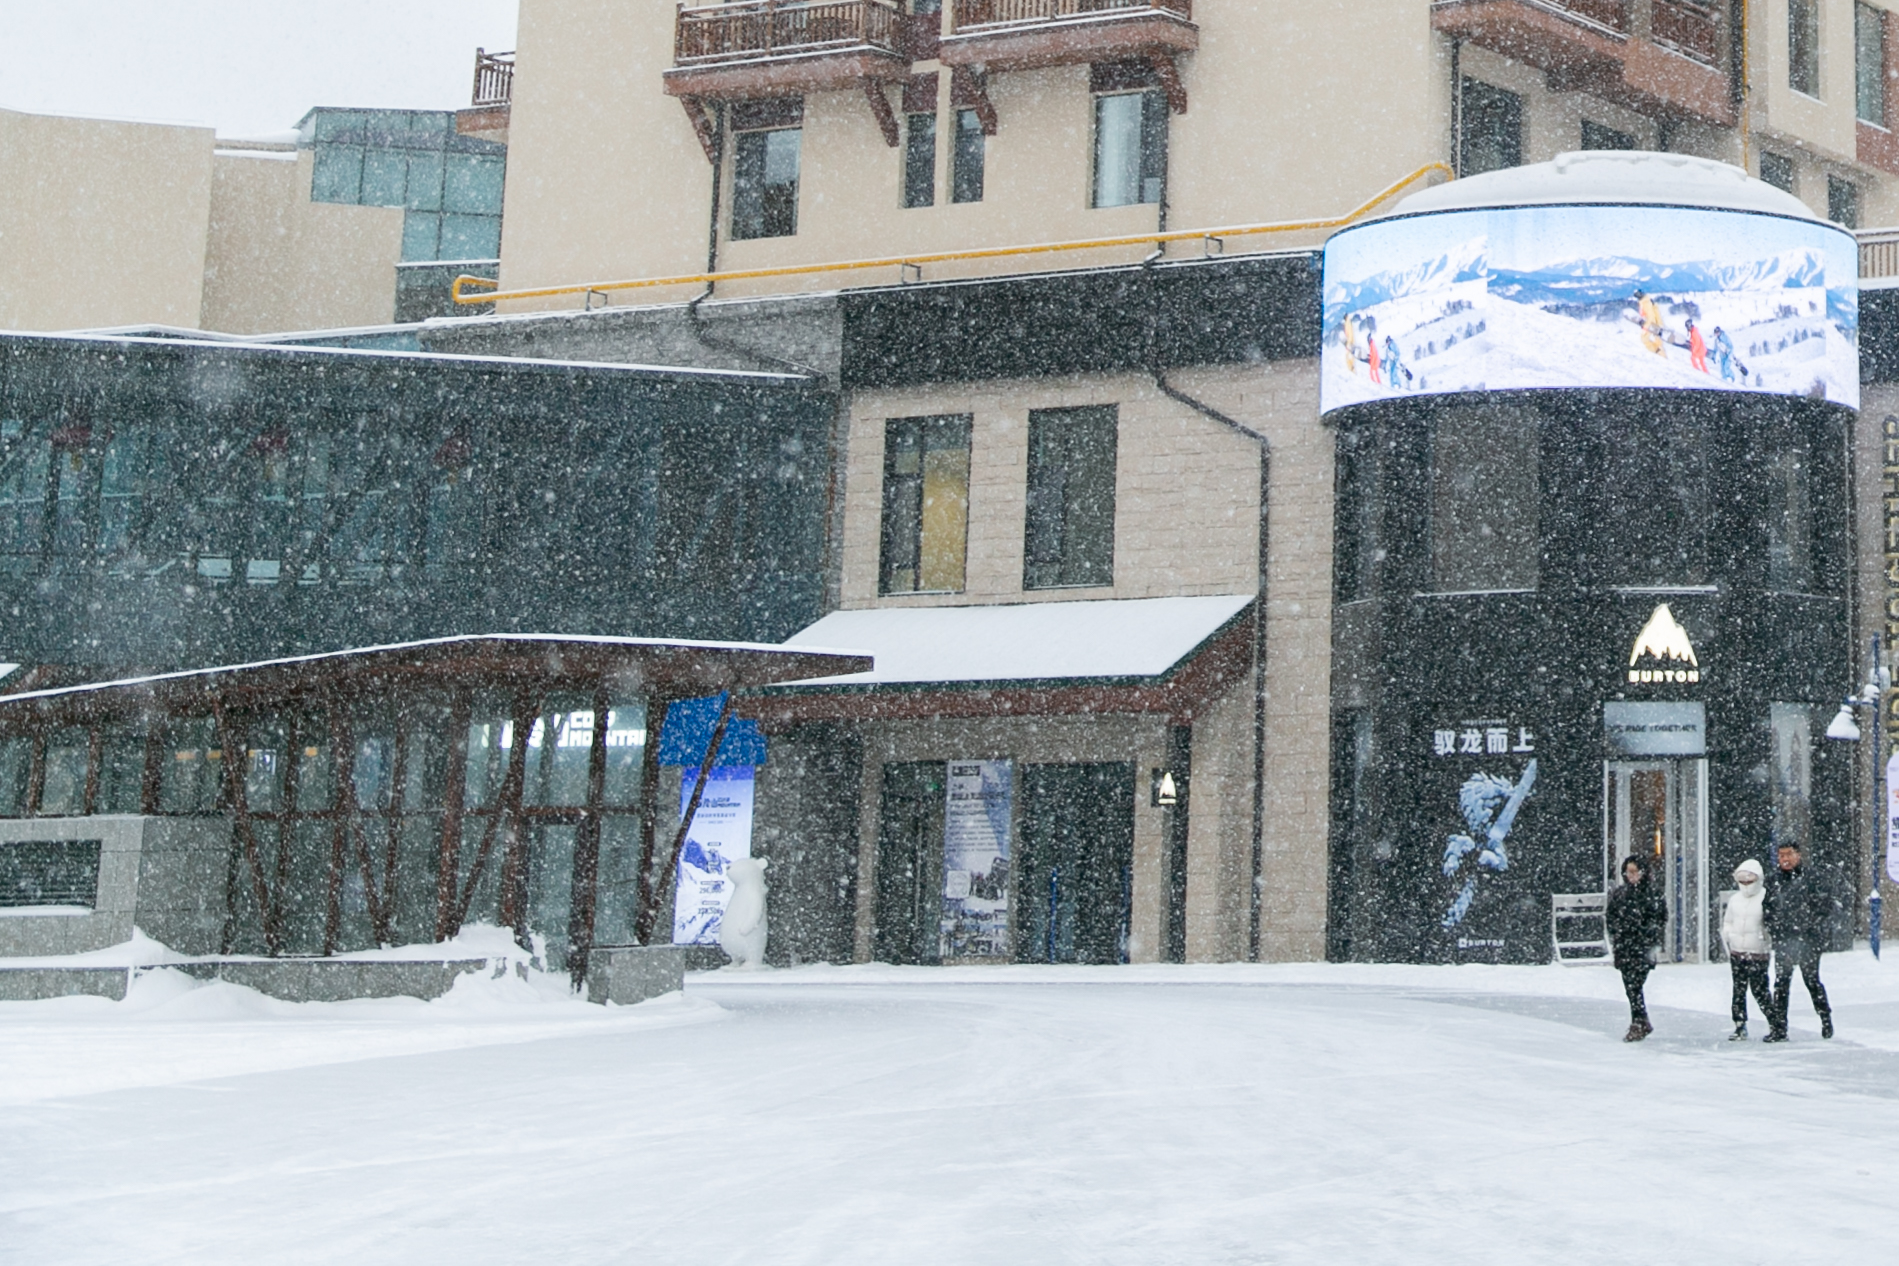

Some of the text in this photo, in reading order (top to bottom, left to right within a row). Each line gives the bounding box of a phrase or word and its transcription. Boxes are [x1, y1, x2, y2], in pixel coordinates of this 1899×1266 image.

[1628, 670, 1699, 683] BURTON
[569, 730, 647, 747] MONTAI
[1434, 727, 1535, 754] 驭龙而上
